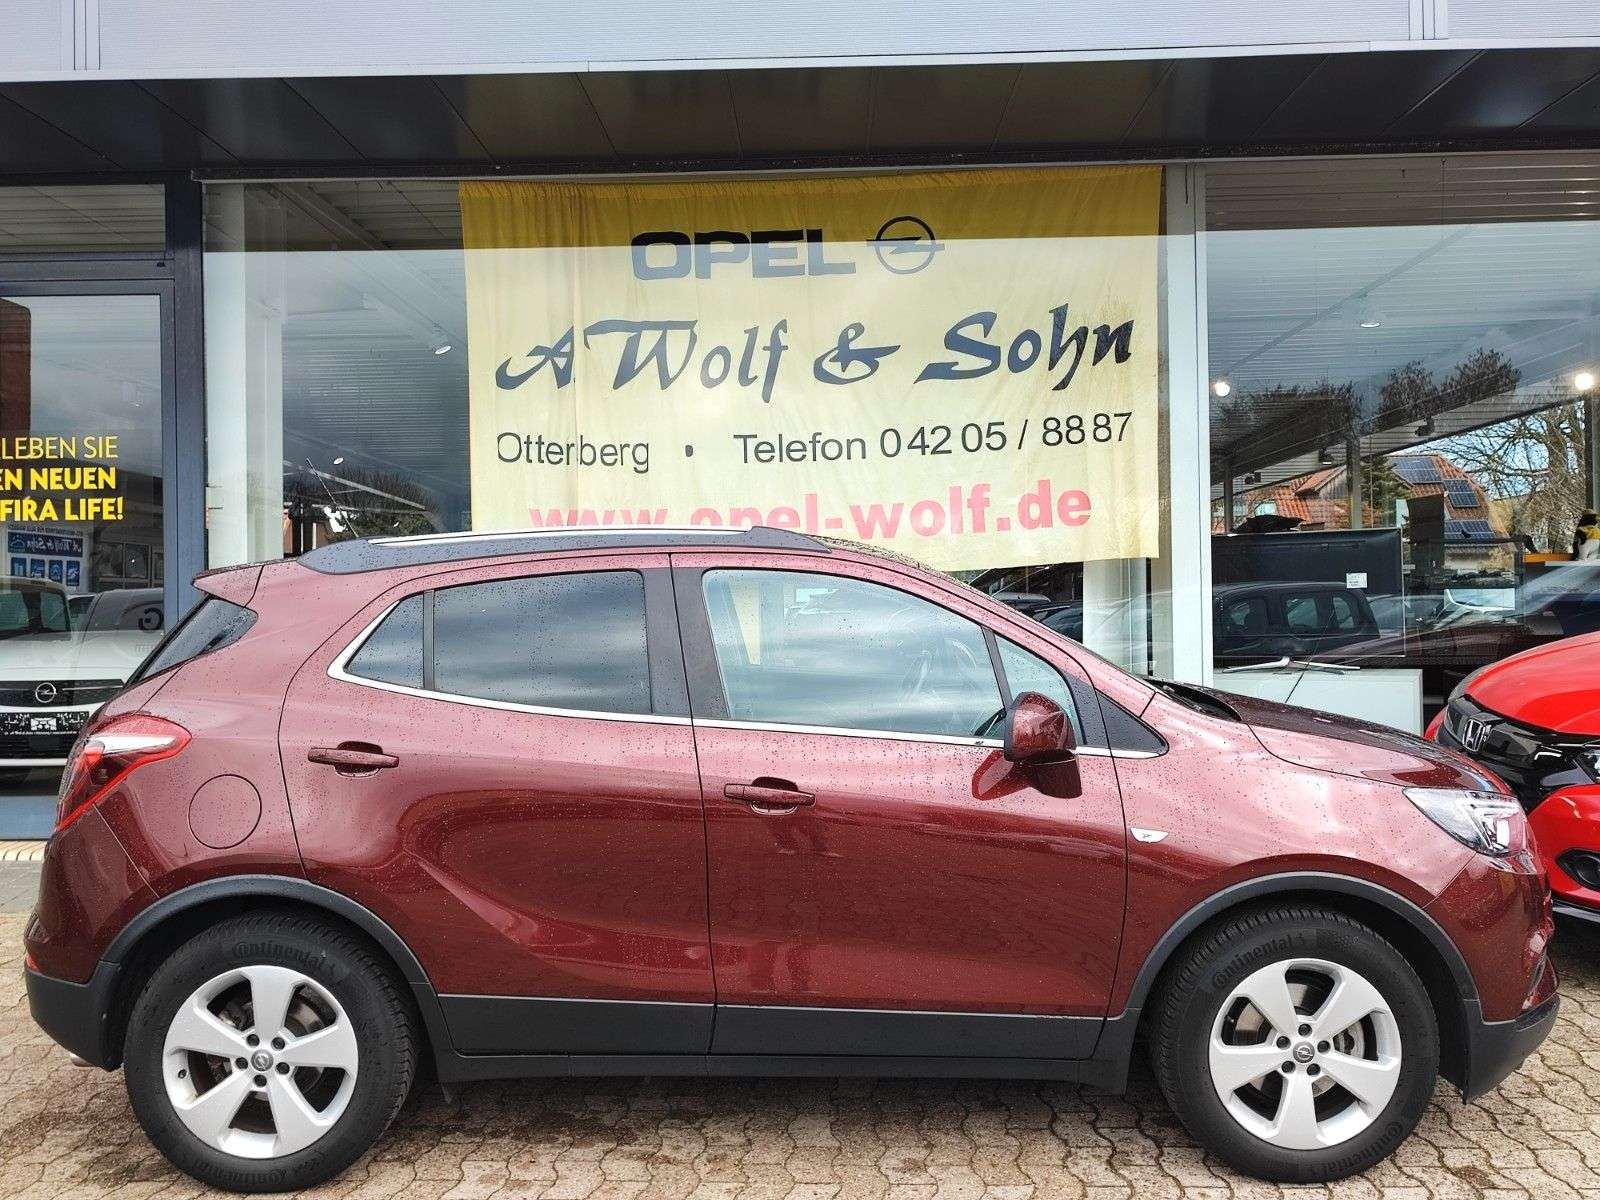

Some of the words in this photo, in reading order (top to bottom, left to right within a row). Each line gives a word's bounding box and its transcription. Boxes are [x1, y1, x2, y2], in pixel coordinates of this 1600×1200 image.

[631, 228, 856, 280] OPEL
[583, 319, 788, 404] Wolf
[813, 321, 901, 385] &
[914, 303, 1134, 391] Sohn
[1, 436, 76, 459] LEBEN
[83, 435, 119, 459] SIE
[496, 431, 649, 474] Otterberg
[733, 431, 866, 463] Telefon
[0, 467, 23, 490] N
[30, 467, 116, 490] NEUEN
[0, 497, 58, 521] FIRA
[64, 497, 124, 521] LIFE!
[529, 479, 1091, 540] wwwoel-wolf.de
